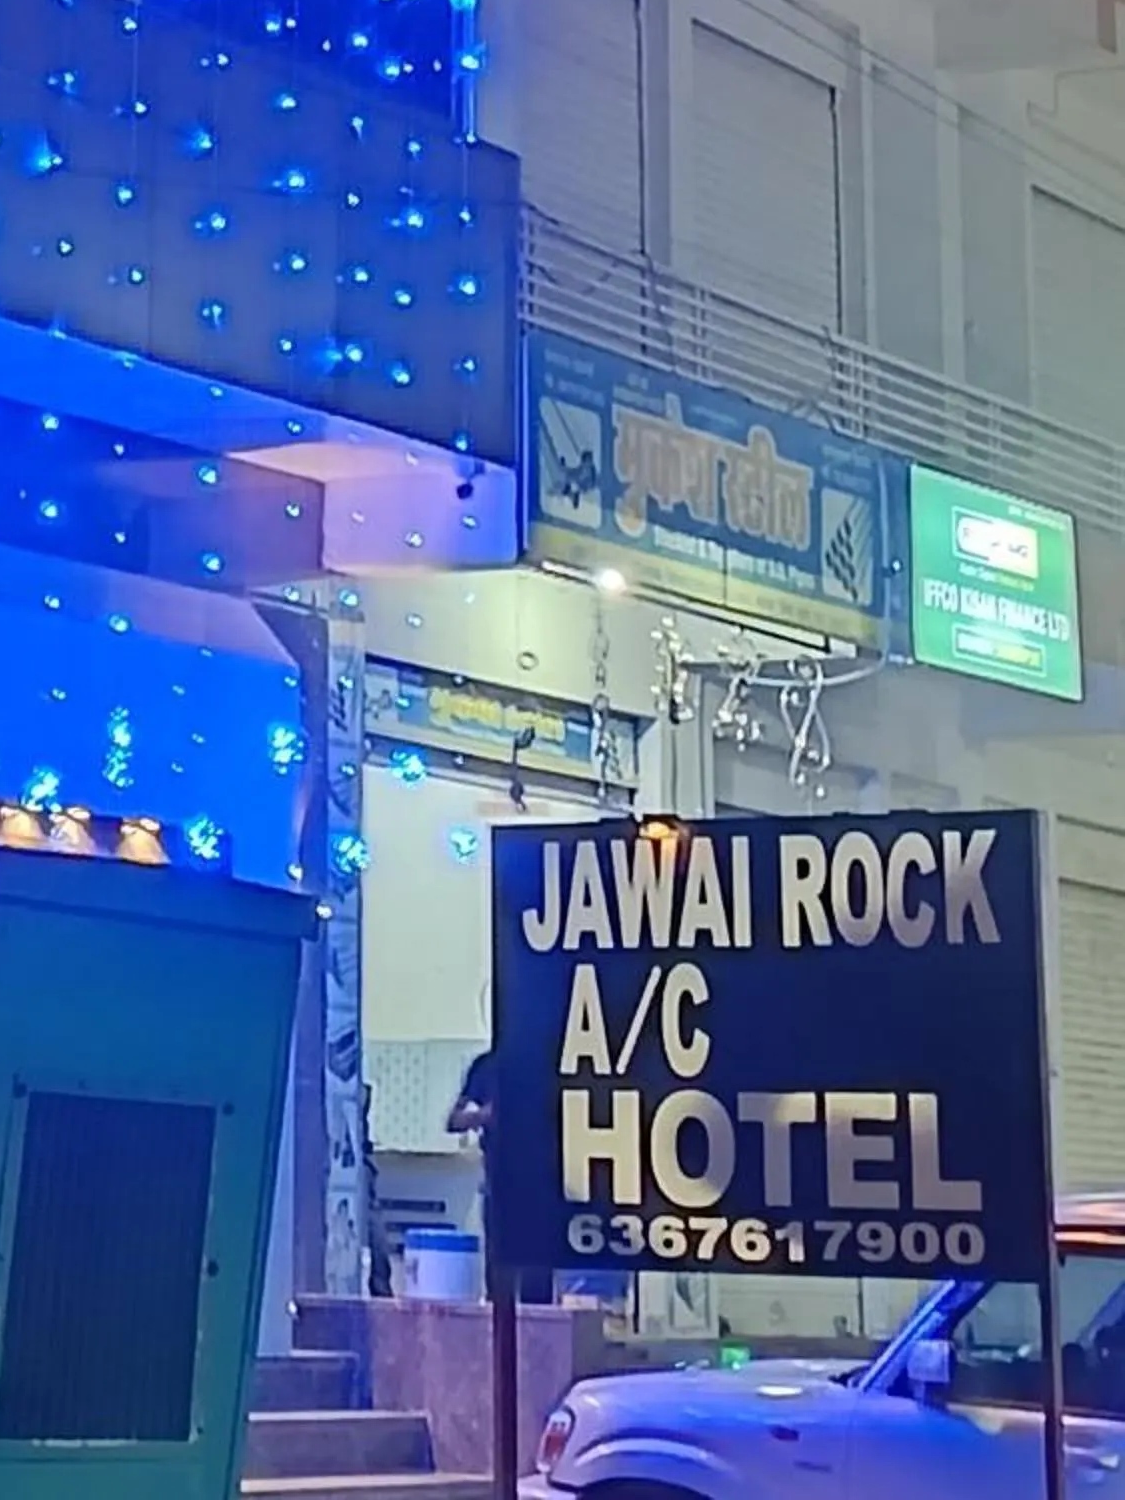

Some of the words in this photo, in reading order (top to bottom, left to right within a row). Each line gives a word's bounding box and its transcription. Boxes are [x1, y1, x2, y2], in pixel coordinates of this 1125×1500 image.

[924, 578, 958, 613] IFFCO
[522, 832, 752, 952] JAWAI
[779, 828, 1001, 949] ROCK
[560, 962, 711, 1078] A/C
[561, 1089, 983, 1211] HOTEL
[567, 1213, 985, 1265] 6367617900
